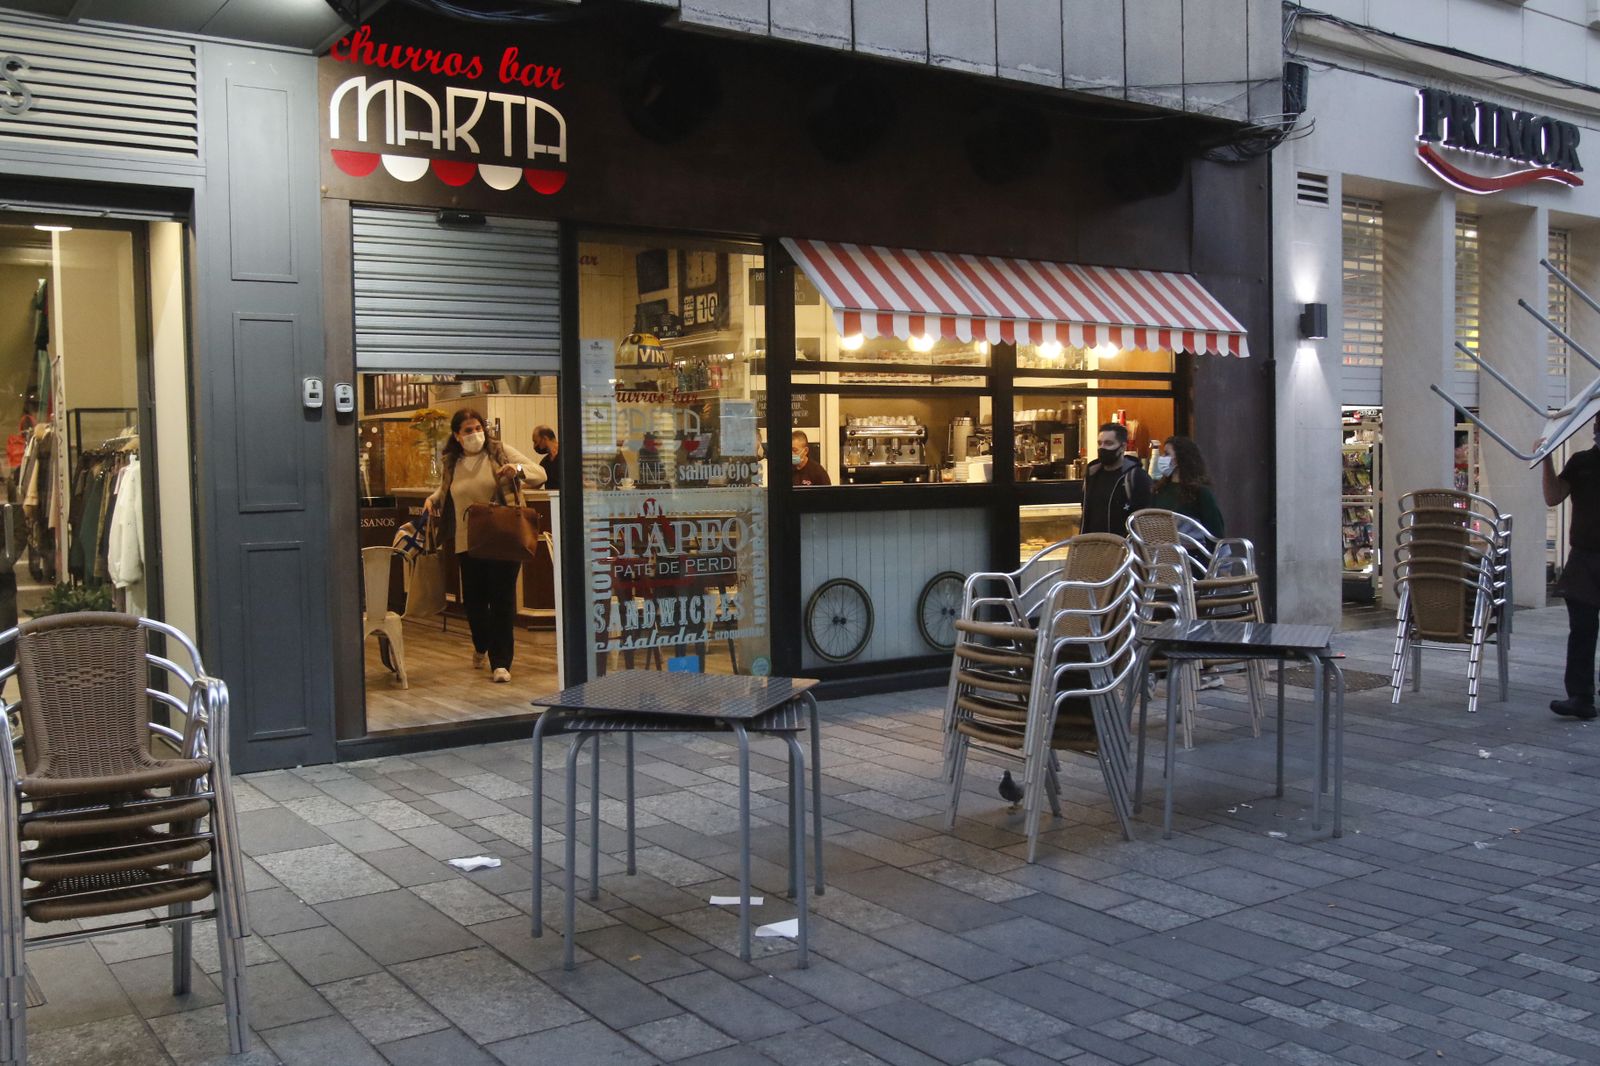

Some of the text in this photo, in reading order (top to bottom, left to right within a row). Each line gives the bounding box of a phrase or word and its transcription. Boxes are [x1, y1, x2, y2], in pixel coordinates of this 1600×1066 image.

[331, 24, 565, 90] churros bar
[329, 75, 568, 163] MARTA
[1416, 87, 1584, 173] PRIMOR
[613, 517, 749, 558] TAPEO
[658, 561, 680, 574] DE
[593, 594, 746, 633] SANDWICHES
[595, 627, 712, 653] ensaladas
